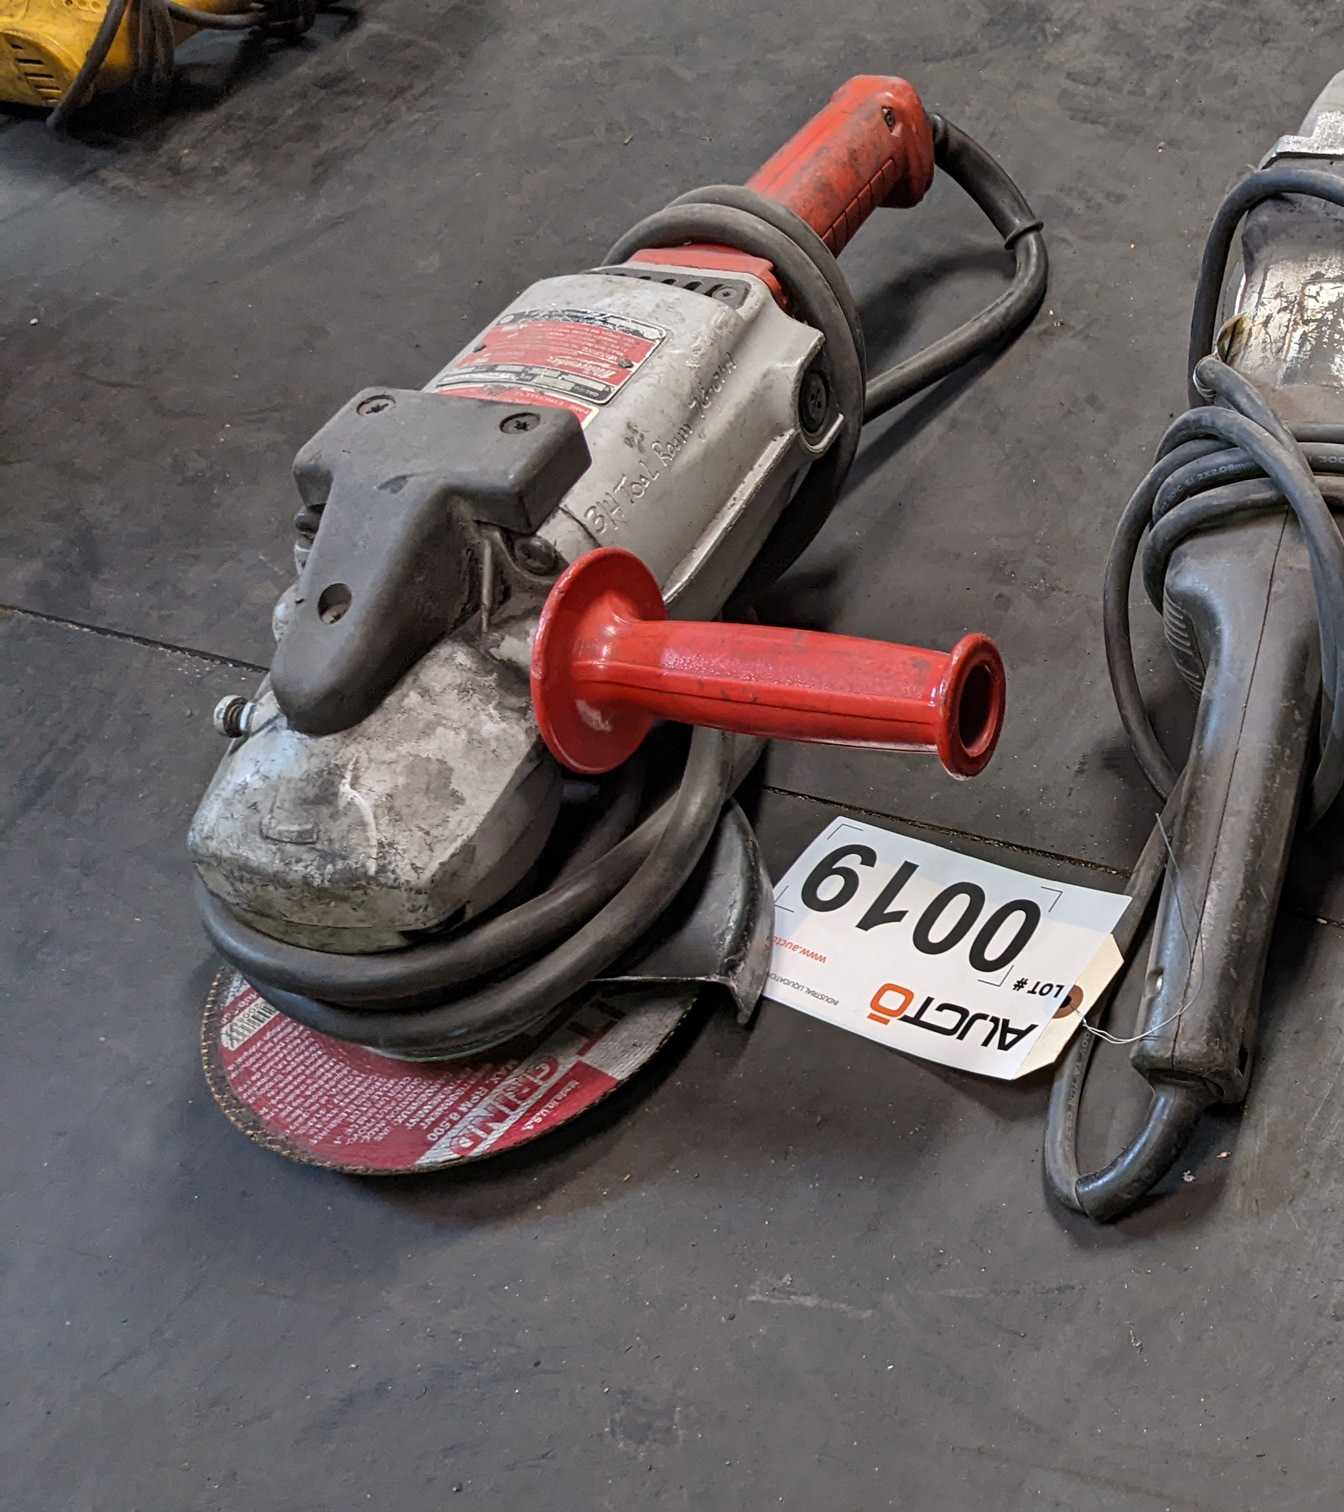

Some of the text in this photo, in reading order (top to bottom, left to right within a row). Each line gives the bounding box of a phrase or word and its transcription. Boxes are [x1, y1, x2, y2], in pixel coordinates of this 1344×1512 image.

[801, 844, 1041, 973] 0019
[804, 987, 839, 1006] INDUSTRIAL
[1013, 977, 1065, 998] LOT #
[444, 1052, 563, 1160] GRIND
[456, 1083, 487, 1114] RPM
